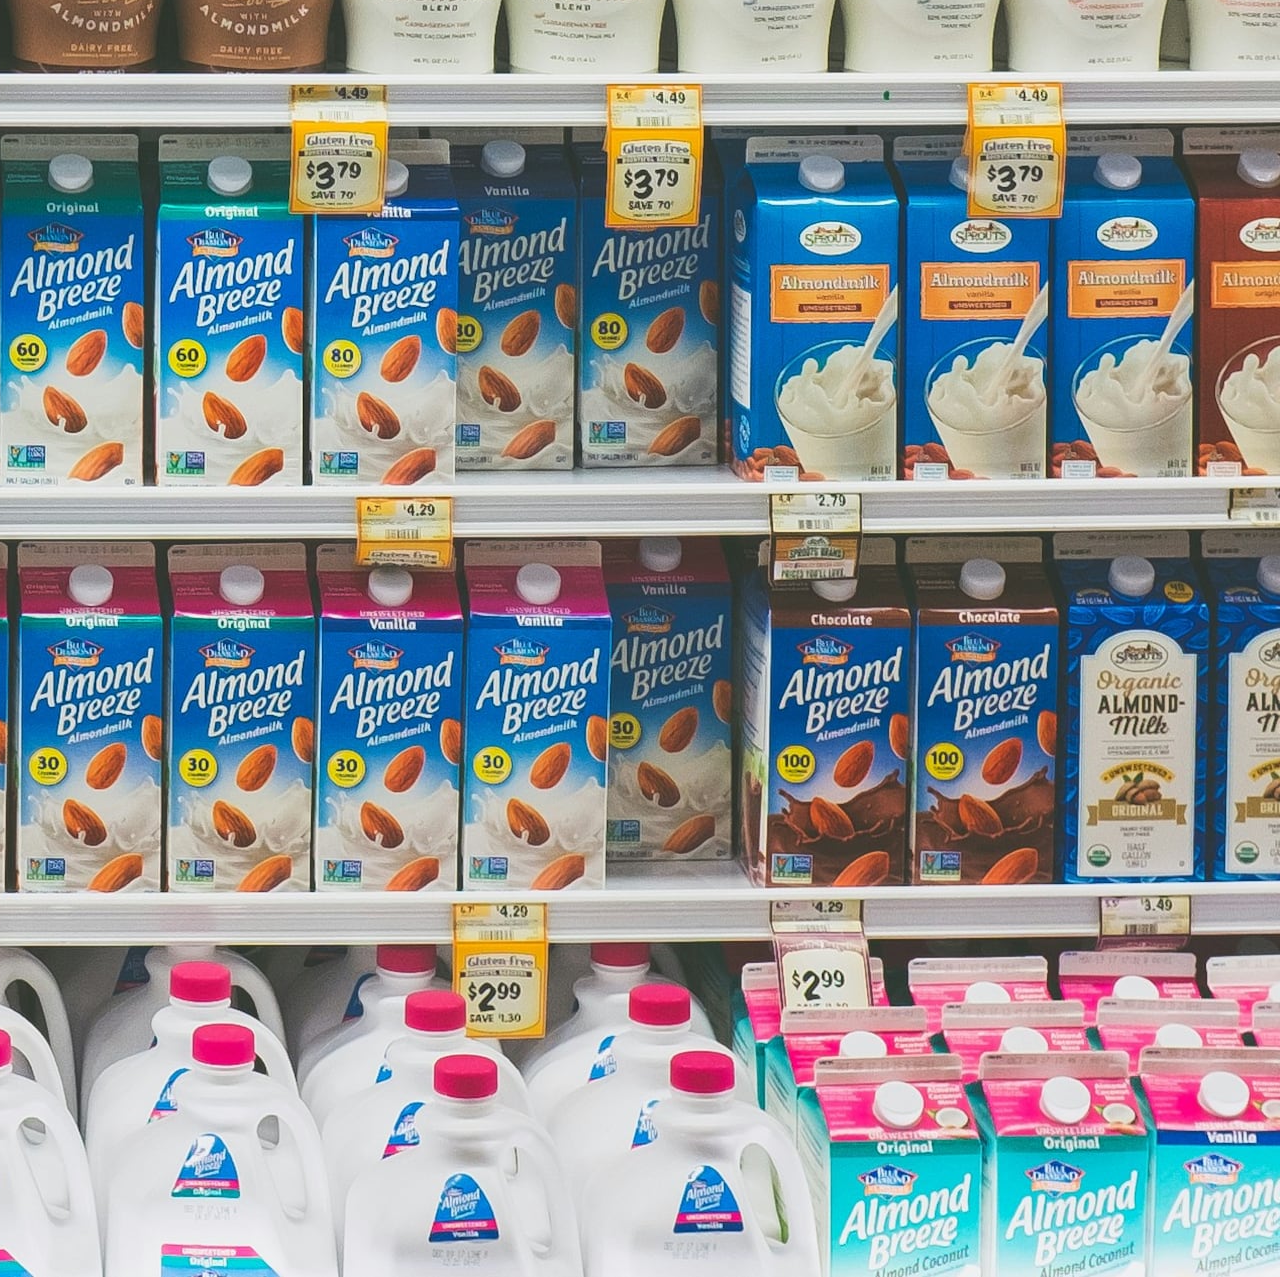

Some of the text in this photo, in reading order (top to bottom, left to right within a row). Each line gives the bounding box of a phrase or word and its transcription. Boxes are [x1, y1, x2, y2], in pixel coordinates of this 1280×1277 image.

[50, 0, 154, 32] ALMONDMILK
[46, 201, 100, 215] Original
[779, 274, 880, 291] Almondmilk
[368, 618, 417, 632] Vanilla
[811, 613, 873, 627] Chocolate
[329, 653, 453, 716] Almond
[1096, 671, 1181, 698] Organic
[354, 691, 440, 741] Breeze
[1109, 713, 1168, 736] Milk
[335, 759, 357, 773] 30
[782, 755, 810, 769] 100
[1111, 805, 1163, 817] ORIGINAL
[876, 1141, 933, 1154] Original
[838, 1174, 972, 1245] Almond
[867, 1215, 957, 1270] Breeze
